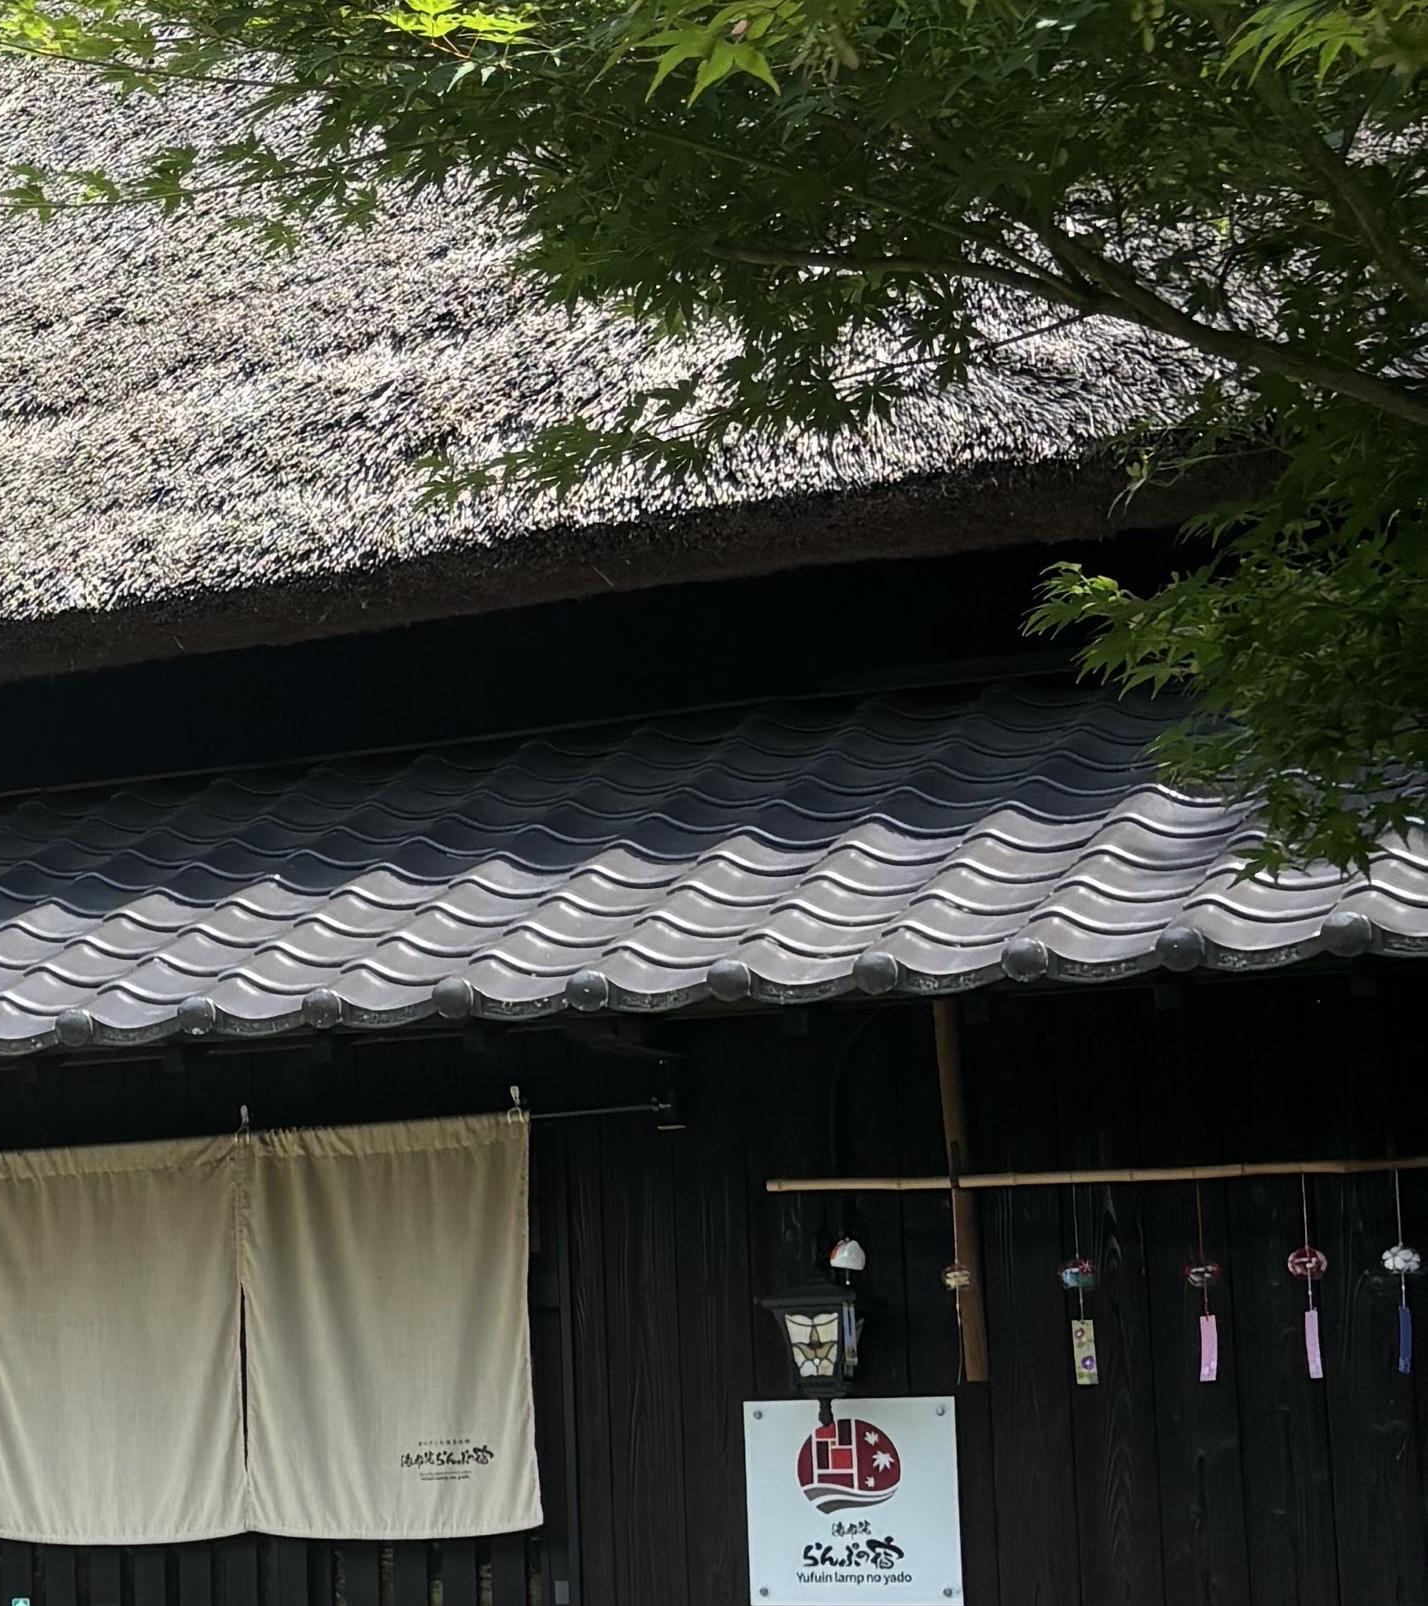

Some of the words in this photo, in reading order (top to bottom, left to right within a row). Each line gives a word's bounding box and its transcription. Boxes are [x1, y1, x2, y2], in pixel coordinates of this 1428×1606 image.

[803, 1535, 904, 1569] らんぷの宿
[797, 1571, 832, 1583] Yufuin
[835, 1571, 864, 1585] lamp
[866, 1573, 882, 1583] no
[884, 1571, 913, 1585] yado
